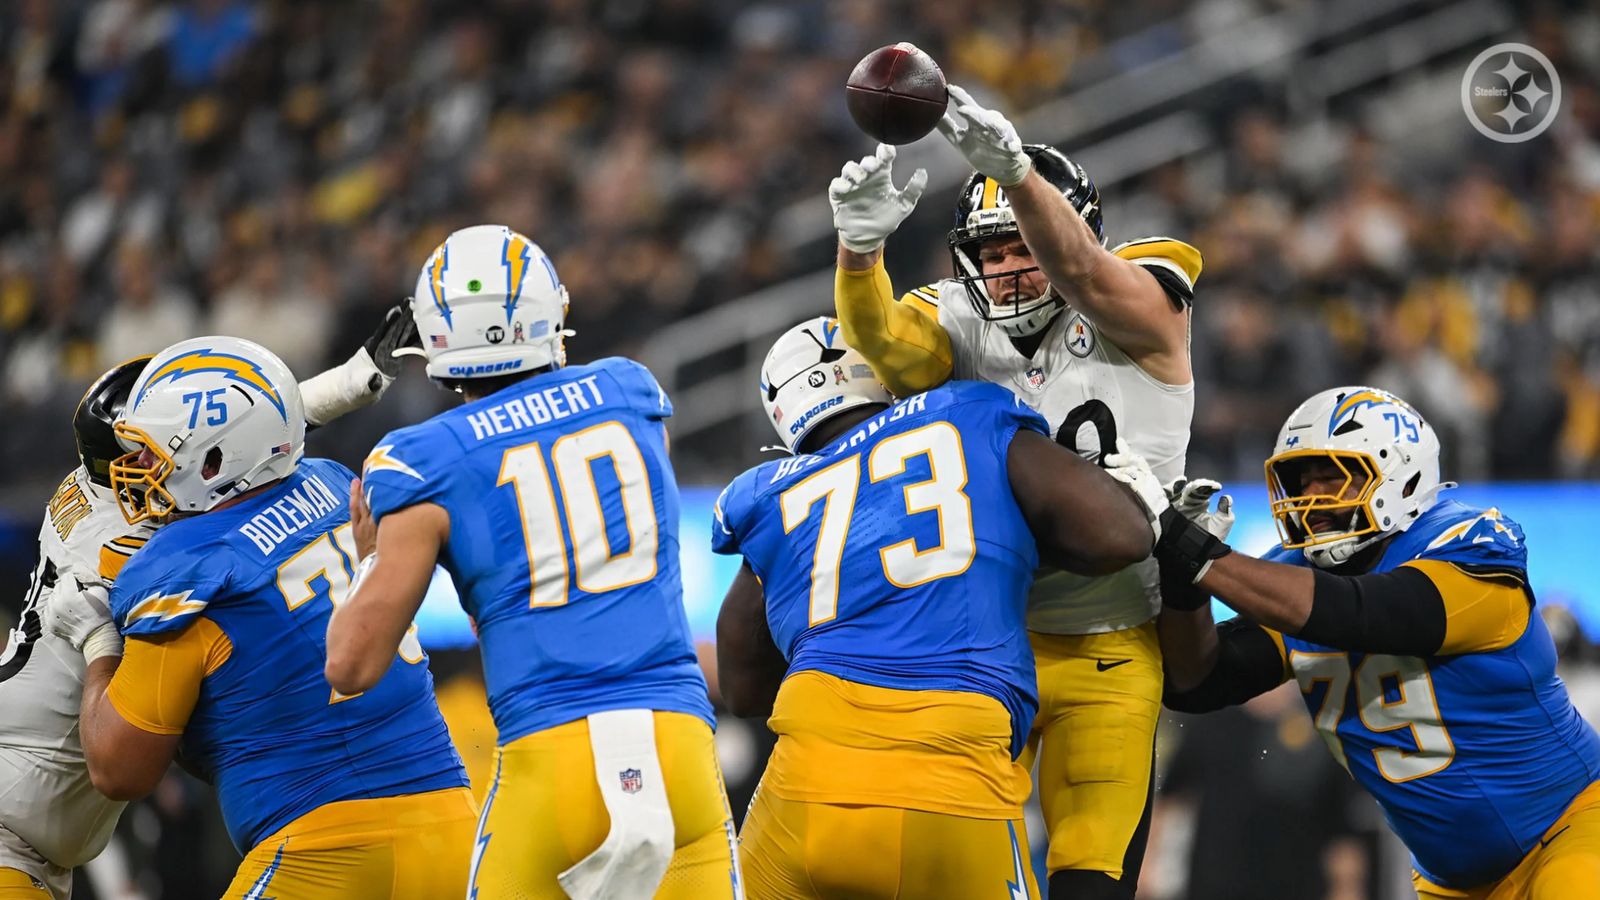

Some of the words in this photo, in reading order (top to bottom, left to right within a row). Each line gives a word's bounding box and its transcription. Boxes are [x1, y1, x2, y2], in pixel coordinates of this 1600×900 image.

[448, 359, 523, 378] CHARGERS
[183, 387, 229, 430] 75
[466, 375, 605, 441] HERBERT
[789, 395, 845, 435] CHARGERS
[238, 474, 341, 557] BOZEMAN
[496, 420, 659, 609] 10
[779, 420, 976, 628] 73
[1289, 649, 1456, 784] 79
